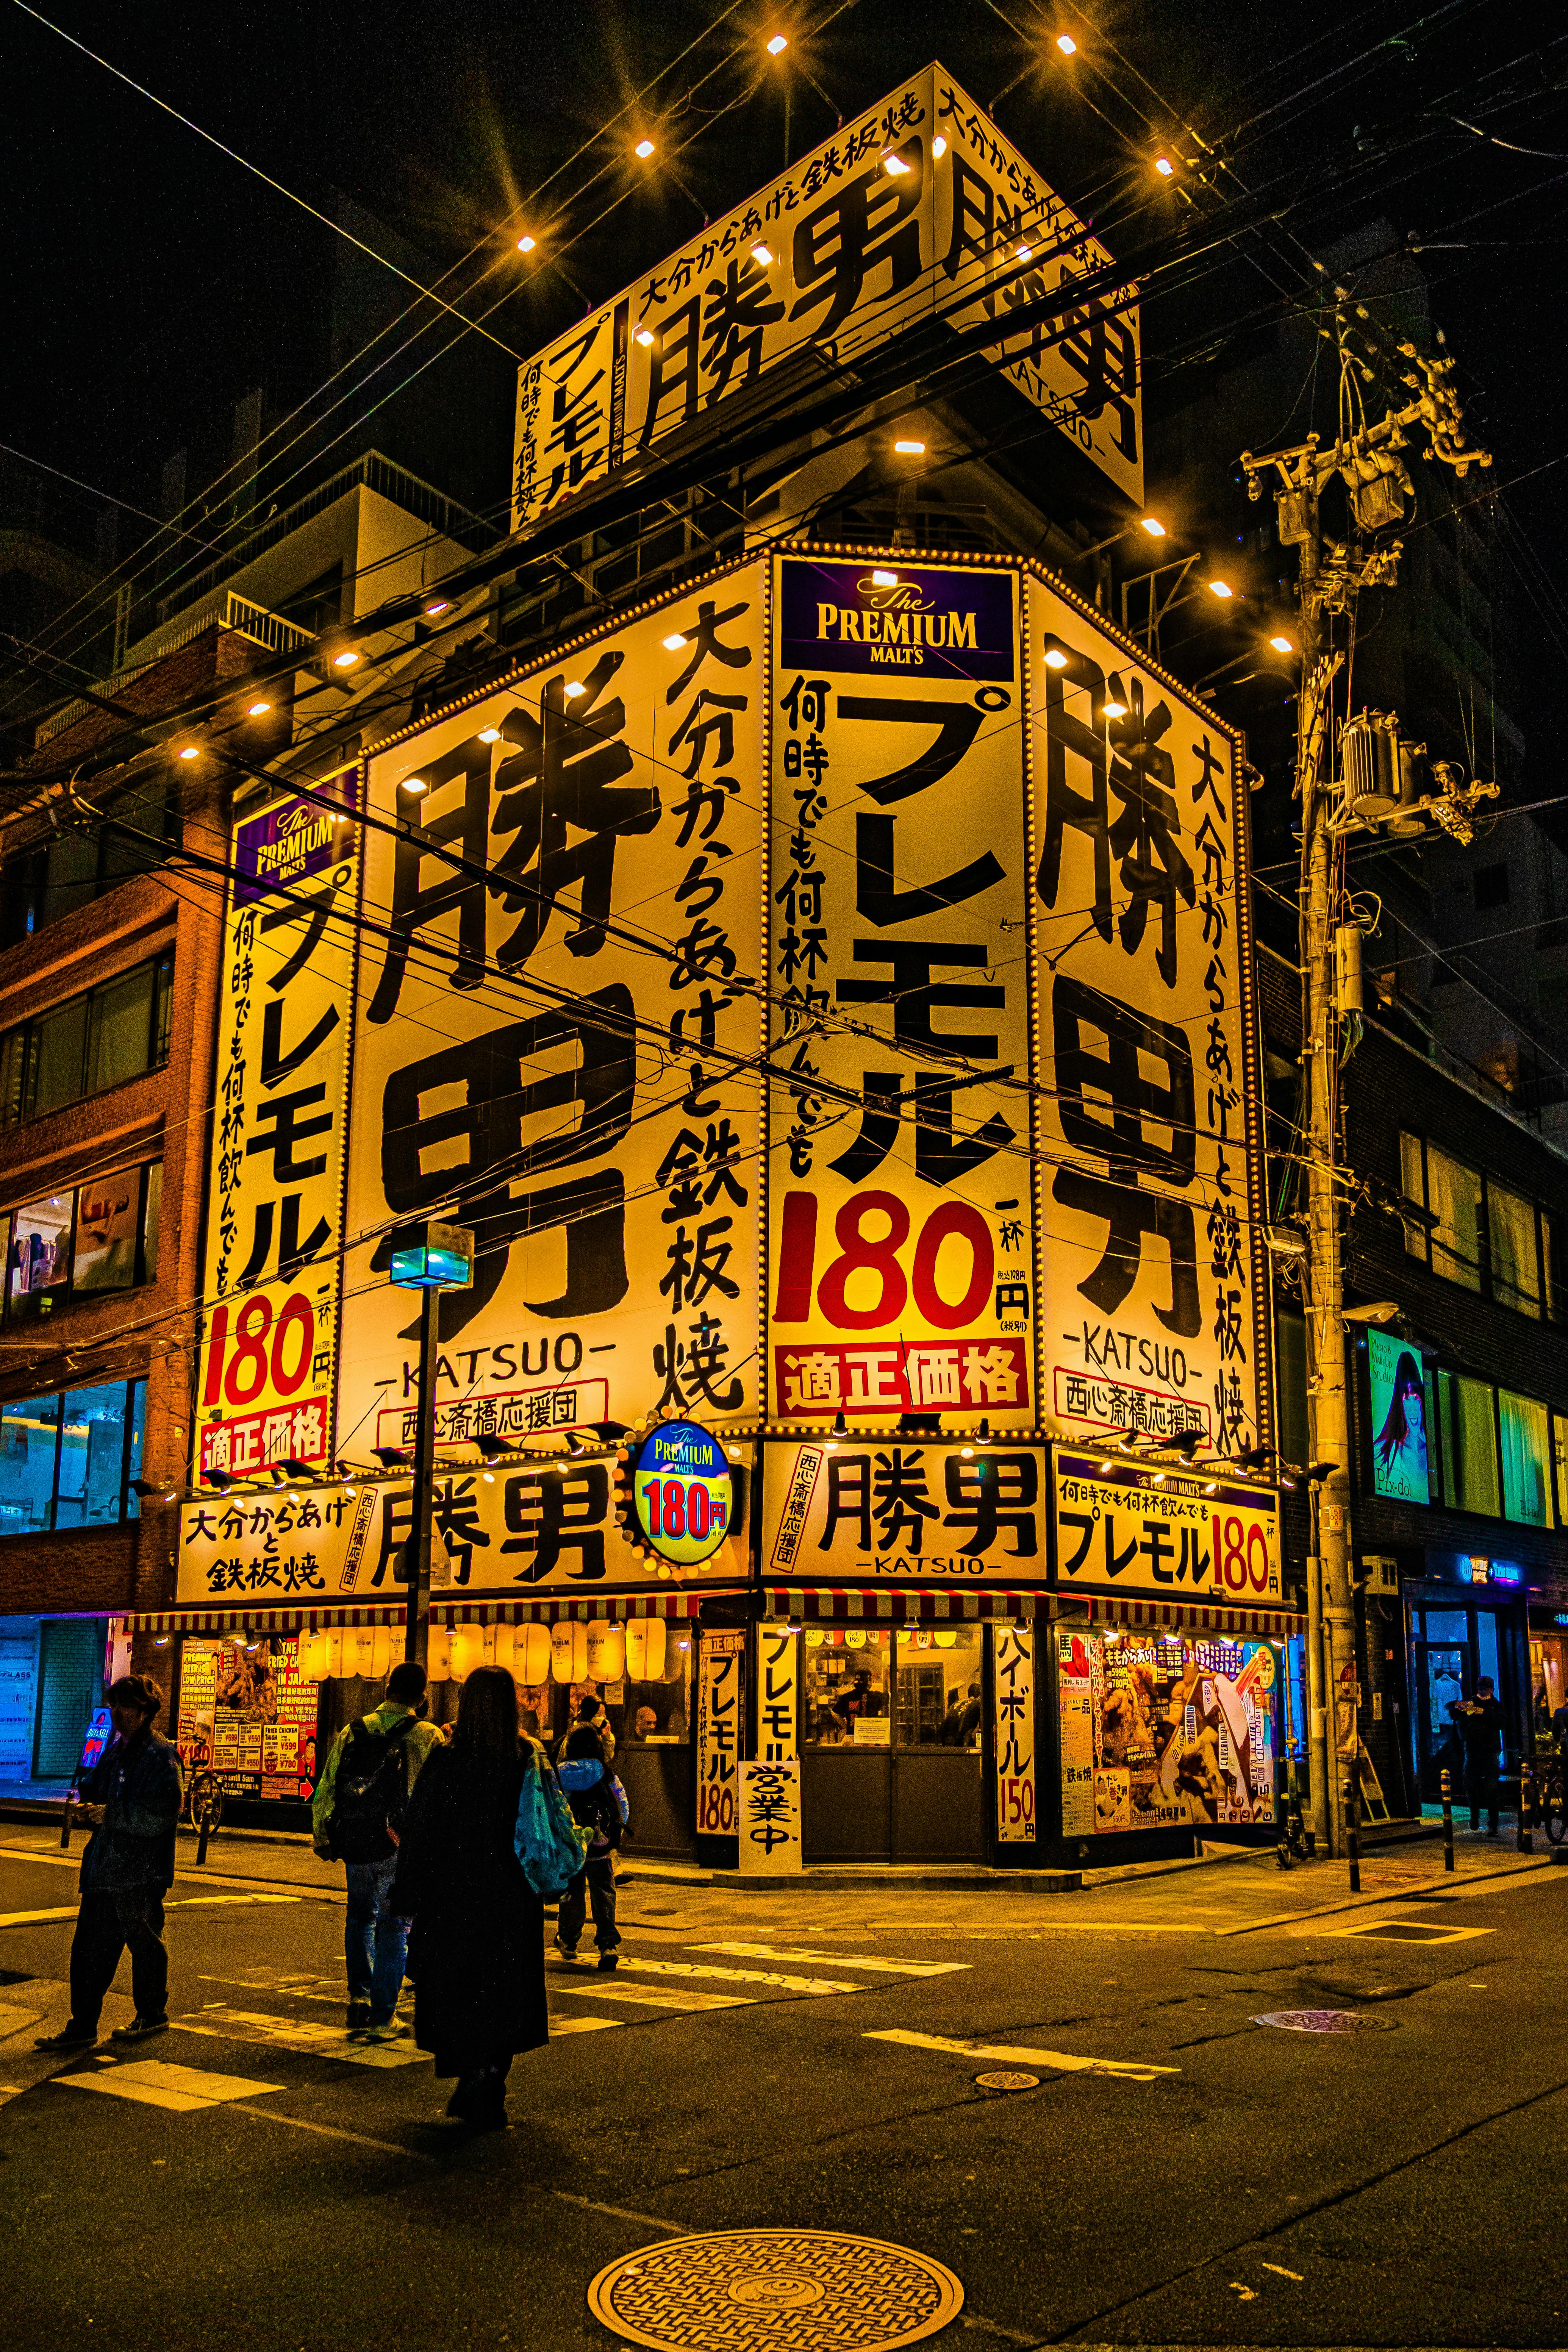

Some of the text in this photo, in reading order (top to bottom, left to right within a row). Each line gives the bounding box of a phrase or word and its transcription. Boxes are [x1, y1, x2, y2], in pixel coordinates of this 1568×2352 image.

[639, 92, 925, 321] 大分からあげと鉄板焼
[637, 134, 923, 450] 勝男
[614, 354, 626, 399] MALT'S
[540, 312, 611, 505] プレモル
[857, 577, 935, 611] The
[816, 603, 979, 649] PREMIUM
[870, 645, 924, 664] MALT'S
[277, 804, 314, 835] The
[256, 816, 333, 876] PREMIUM
[279, 855, 306, 881] MALT'S
[826, 686, 1018, 1188] プレモル
[366, 650, 662, 1344] 勝男
[1036, 632, 1202, 1338] 勝男
[653, 601, 756, 1415] 大分からあげと鉄板焼
[237, 864, 352, 1286] プレモル
[1192, 733, 1251, 1456] 大分からあげと鉄板焼
[216, 910, 256, 1296] 何時でも何杯飲んでも
[995, 1198, 1024, 1252] 一杯
[772, 1190, 994, 1330] 180
[997, 1270, 1025, 1280] 税込198円
[317, 1283, 331, 1328] 一杯
[996, 1283, 1029, 1320] 円
[1000, 1321, 1027, 1332] (税別)
[202, 1293, 314, 1407] 180
[313, 1355, 329, 1383] 円
[1388, 1345, 1392, 1355] &
[785, 1346, 1020, 1410] 適正価格
[1066, 1376, 1202, 1436] 西心斎橋応援団
[204, 1404, 323, 1474] 適正価格
[655, 1439, 713, 1466] PREMIUM
[670, 1424, 698, 1444] The
[674, 1463, 694, 1475] MALT'S
[1179, 1481, 1200, 1497] MALT'S
[1376, 1467, 1412, 1497] Pix-do!
[186, 1496, 356, 1545] 大分からあげ
[642, 1478, 727, 1541] 180 円
[776, 1454, 819, 1564] 西心斎橋応援団
[818, 1448, 1038, 1557] 勝男
[1059, 1479, 1208, 1522] 何時でも何杯飲んでも
[263, 1532, 279, 1553] と
[343, 1493, 373, 1586] 西心斎橋応援団
[371, 1463, 609, 1587] 勝男
[1059, 1506, 1211, 1585] プレモル
[1266, 1518, 1275, 1539] 一杯
[206, 1552, 326, 1591] 鉄板焼
[1212, 1514, 1268, 1593] 180
[1269, 1576, 1279, 1594] 円
[184, 1652, 211, 1663] PREMIUM
[267, 1655, 288, 1668] FRIED
[281, 1642, 297, 1655] THE
[702, 1636, 744, 1652] 適正価格
[1060, 1635, 1072, 1657] 馬
[1106, 1648, 1153, 1666] ももからあげ
[182, 1674, 215, 1685] LOW PRICE
[183, 1663, 206, 1674] BEER IS
[278, 1672, 286, 1685] IN
[1112, 1667, 1128, 1677] 599円
[1112, 1678, 1128, 1689] 780円
[699, 1656, 708, 1782] 何時でも何杯飲んでも
[707, 1651, 737, 1783] プレモル
[997, 1632, 1031, 1777] ハイボール
[1072, 1699, 1090, 1714] 一品
[1067, 1766, 1092, 1783] 鉄板焼
[699, 1784, 733, 1831] 180
[745, 1764, 793, 1856] 営業中
[1001, 1778, 1033, 1824] 150
[1113, 1814, 1126, 1823] 550円
[1025, 1823, 1035, 1836] 円
